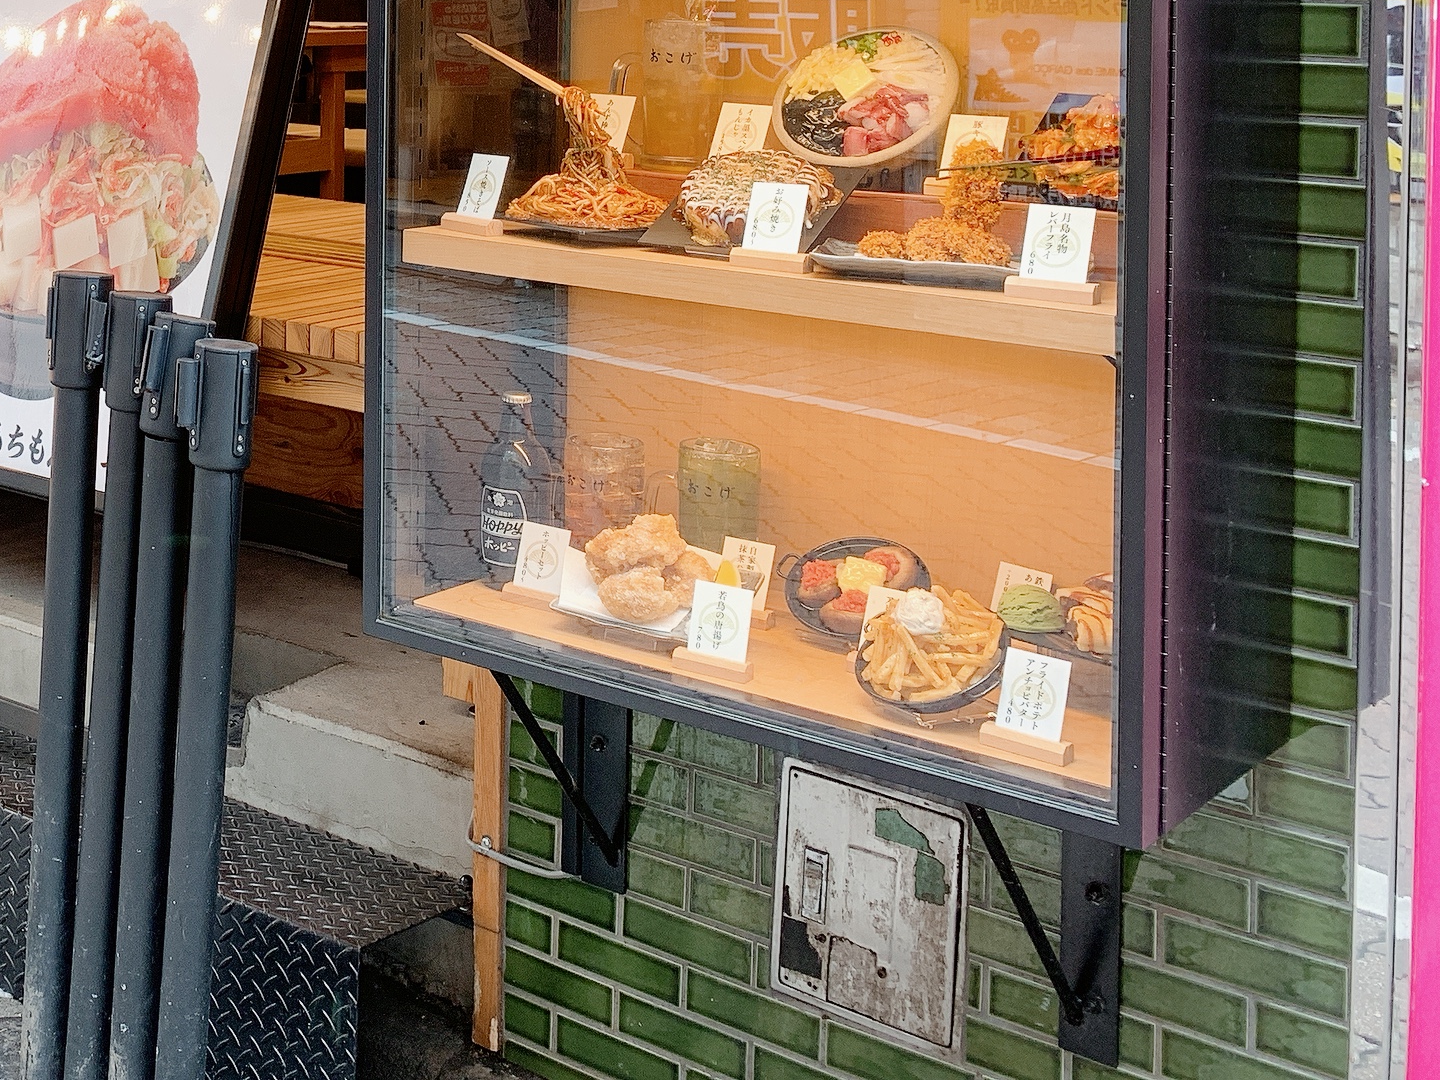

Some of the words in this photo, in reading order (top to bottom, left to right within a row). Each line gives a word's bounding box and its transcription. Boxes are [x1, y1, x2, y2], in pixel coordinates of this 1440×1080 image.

[649, 48, 697, 65] おこげ
[769, 188, 785, 233] お好み焼き
[1042, 211, 1059, 260] レバーフライ
[1056, 212, 1072, 255] 月島名物
[1027, 250, 1036, 275] 680
[567, 474, 606, 493] おこげ
[687, 478, 735, 499] おこげ
[484, 536, 516, 552] ホッピー
[536, 530, 550, 580] ホッピーセット
[712, 590, 727, 650] 若鳥の唐揚げ
[695, 626, 703, 649] 780
[1019, 658, 1035, 727] アンチョビバター
[1032, 661, 1048, 731] フライドポテト
[1005, 698, 1014, 724] 480
